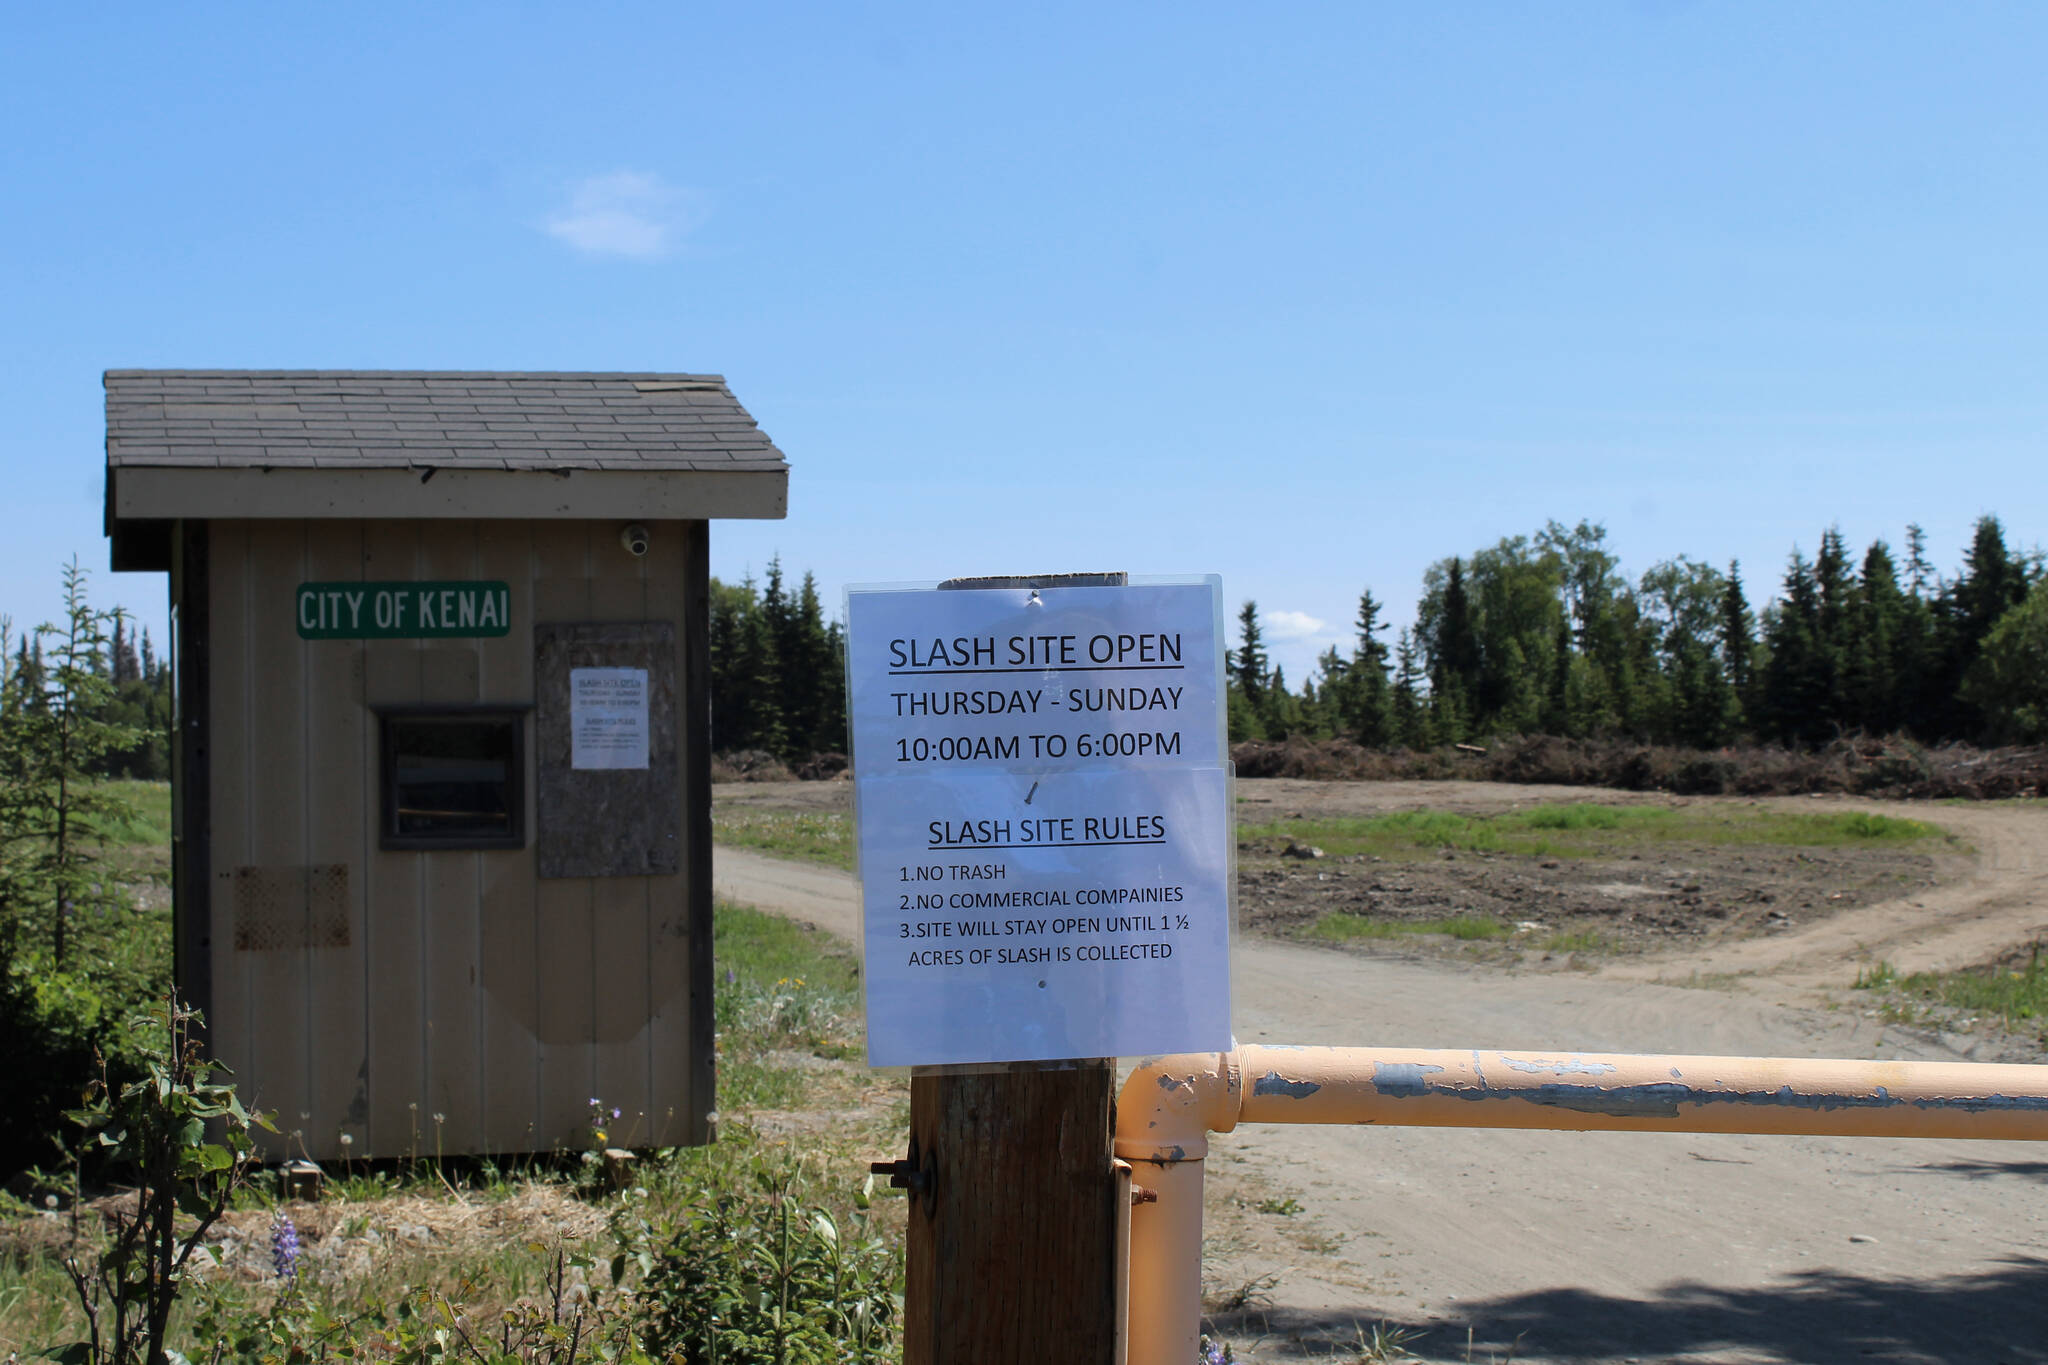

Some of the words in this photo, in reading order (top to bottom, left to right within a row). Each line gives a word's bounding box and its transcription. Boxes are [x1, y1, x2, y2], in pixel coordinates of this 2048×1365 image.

[300, 591, 364, 629] CITY
[374, 591, 409, 629] OF
[419, 590, 507, 628] KENAI
[889, 637, 995, 668] SLASH
[1009, 636, 1076, 665] SITE
[1089, 634, 1181, 663] OPEN
[891, 690, 1042, 716] THURSDAY
[1069, 687, 1183, 712] SUNDAY
[897, 736, 1019, 761] 10:00AM
[1029, 735, 1067, 758] TO
[1077, 732, 1180, 757] 6:00PM
[928, 819, 1011, 845] SLASH
[1020, 818, 1074, 842] SITE
[1084, 816, 1165, 841] RULES
[949, 864, 1005, 880] TRASH
[950, 891, 1071, 908] COMMERCIAL
[1076, 887, 1183, 905] COMPAINIES
[958, 921, 1000, 936] WILL
[1005, 920, 1046, 935] STAY
[1053, 918, 1099, 933] OPEN
[1107, 916, 1156, 932] UNTIL
[909, 950, 963, 966] ACRES
[970, 949, 992, 964] OF
[998, 947, 1050, 963] SLASH
[1058, 947, 1071, 961] IS
[1077, 944, 1172, 961] COLLECTED
